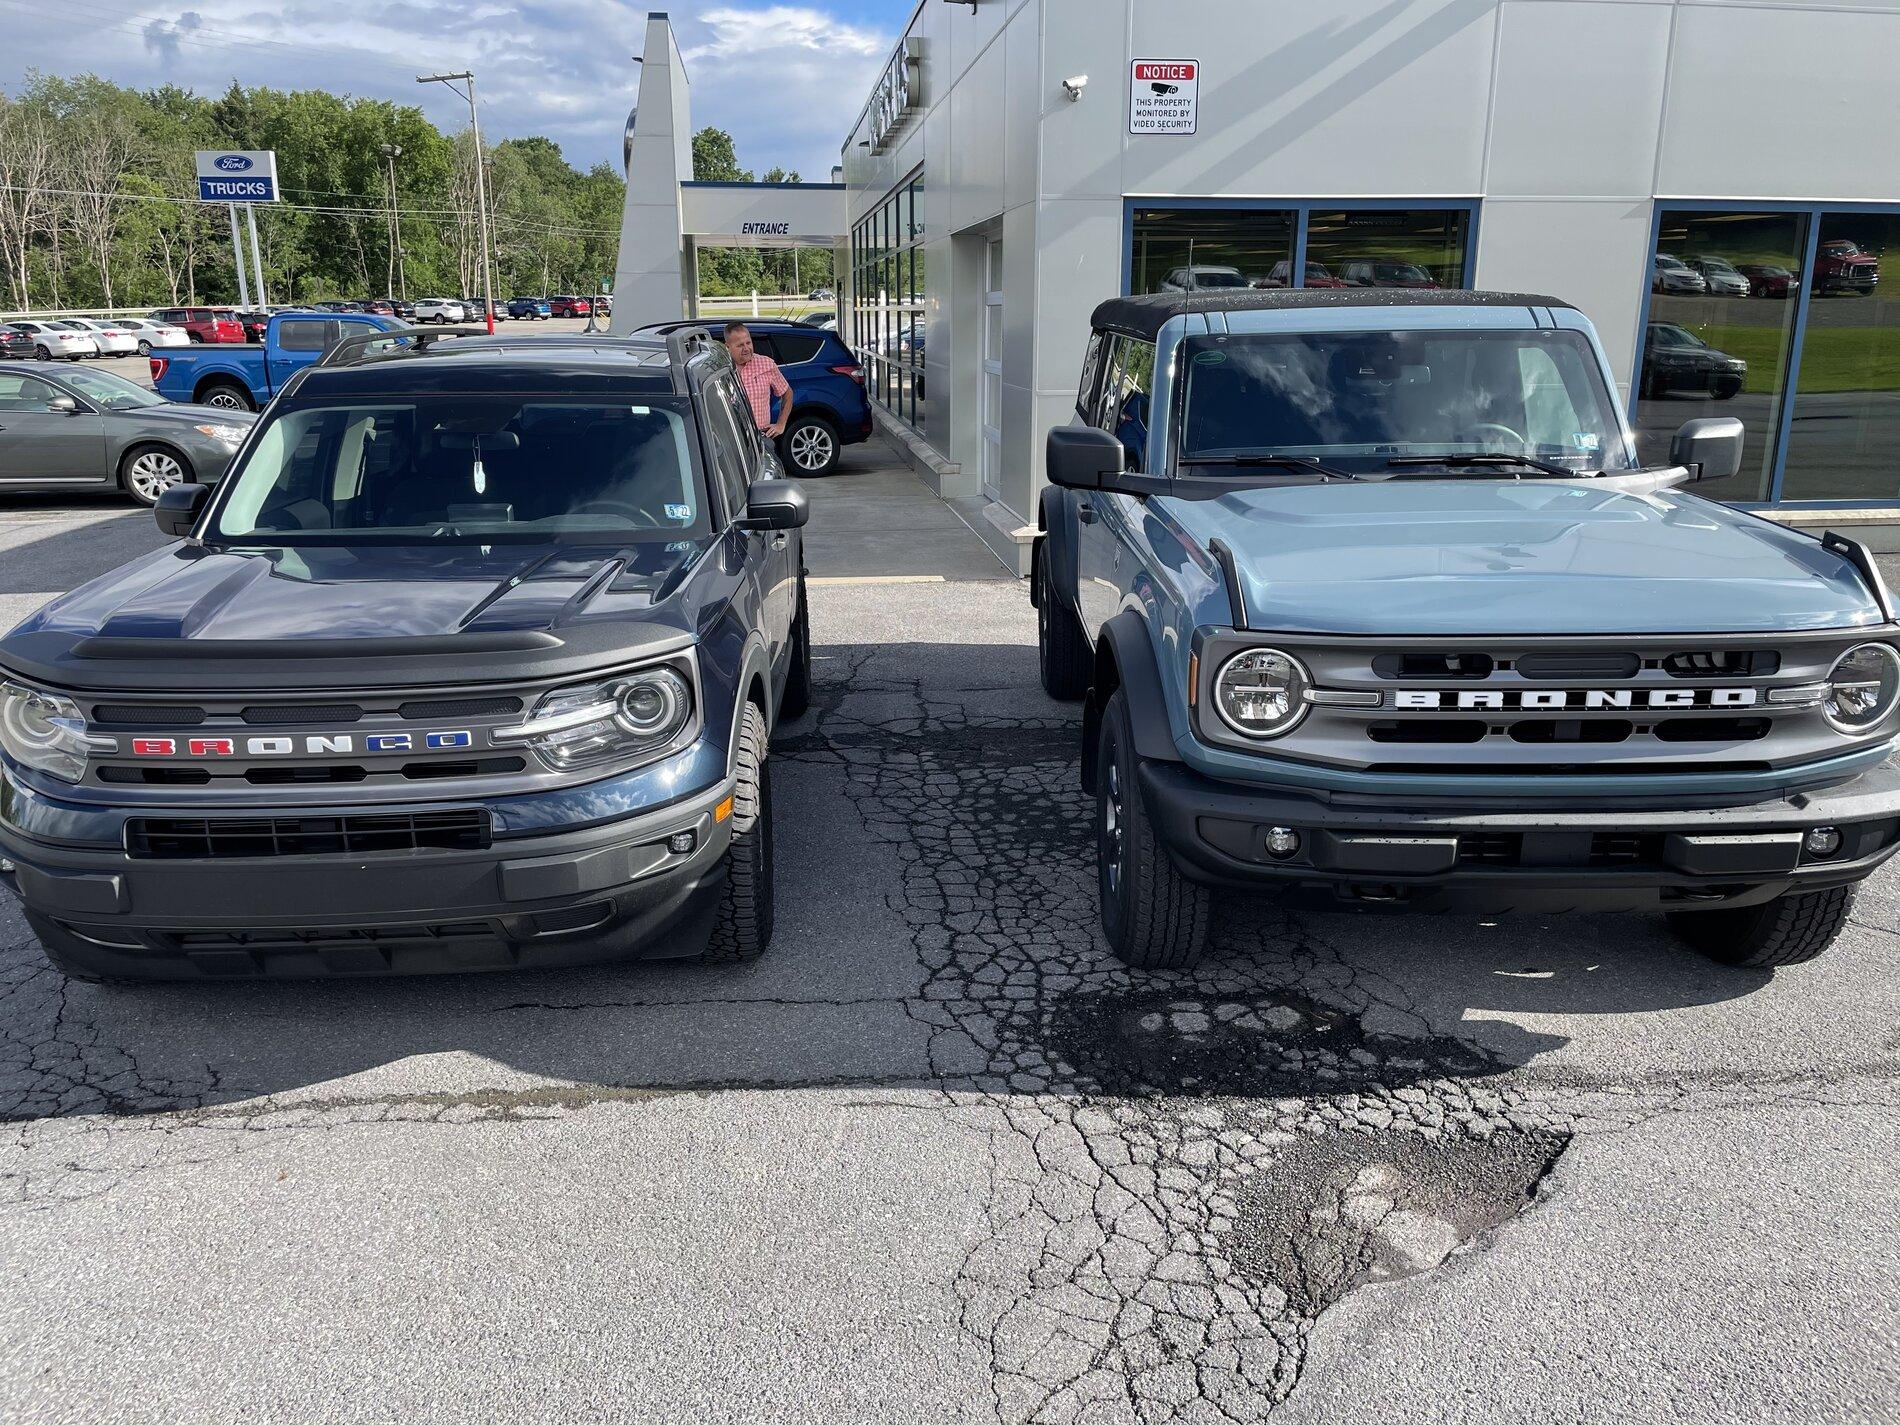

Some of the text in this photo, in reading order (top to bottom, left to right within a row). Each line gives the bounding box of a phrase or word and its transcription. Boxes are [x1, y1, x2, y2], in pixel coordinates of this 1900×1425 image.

[1143, 66, 1187, 79] NOTICE
[1136, 99, 1192, 107] THIS PROPERTY
[221, 158, 246, 169] Ford
[207, 182, 266, 195] TRUCKS
[741, 222, 789, 235] ENTRANCE
[1394, 688, 1757, 708] BRONCO
[132, 730, 473, 756] BRONCO
